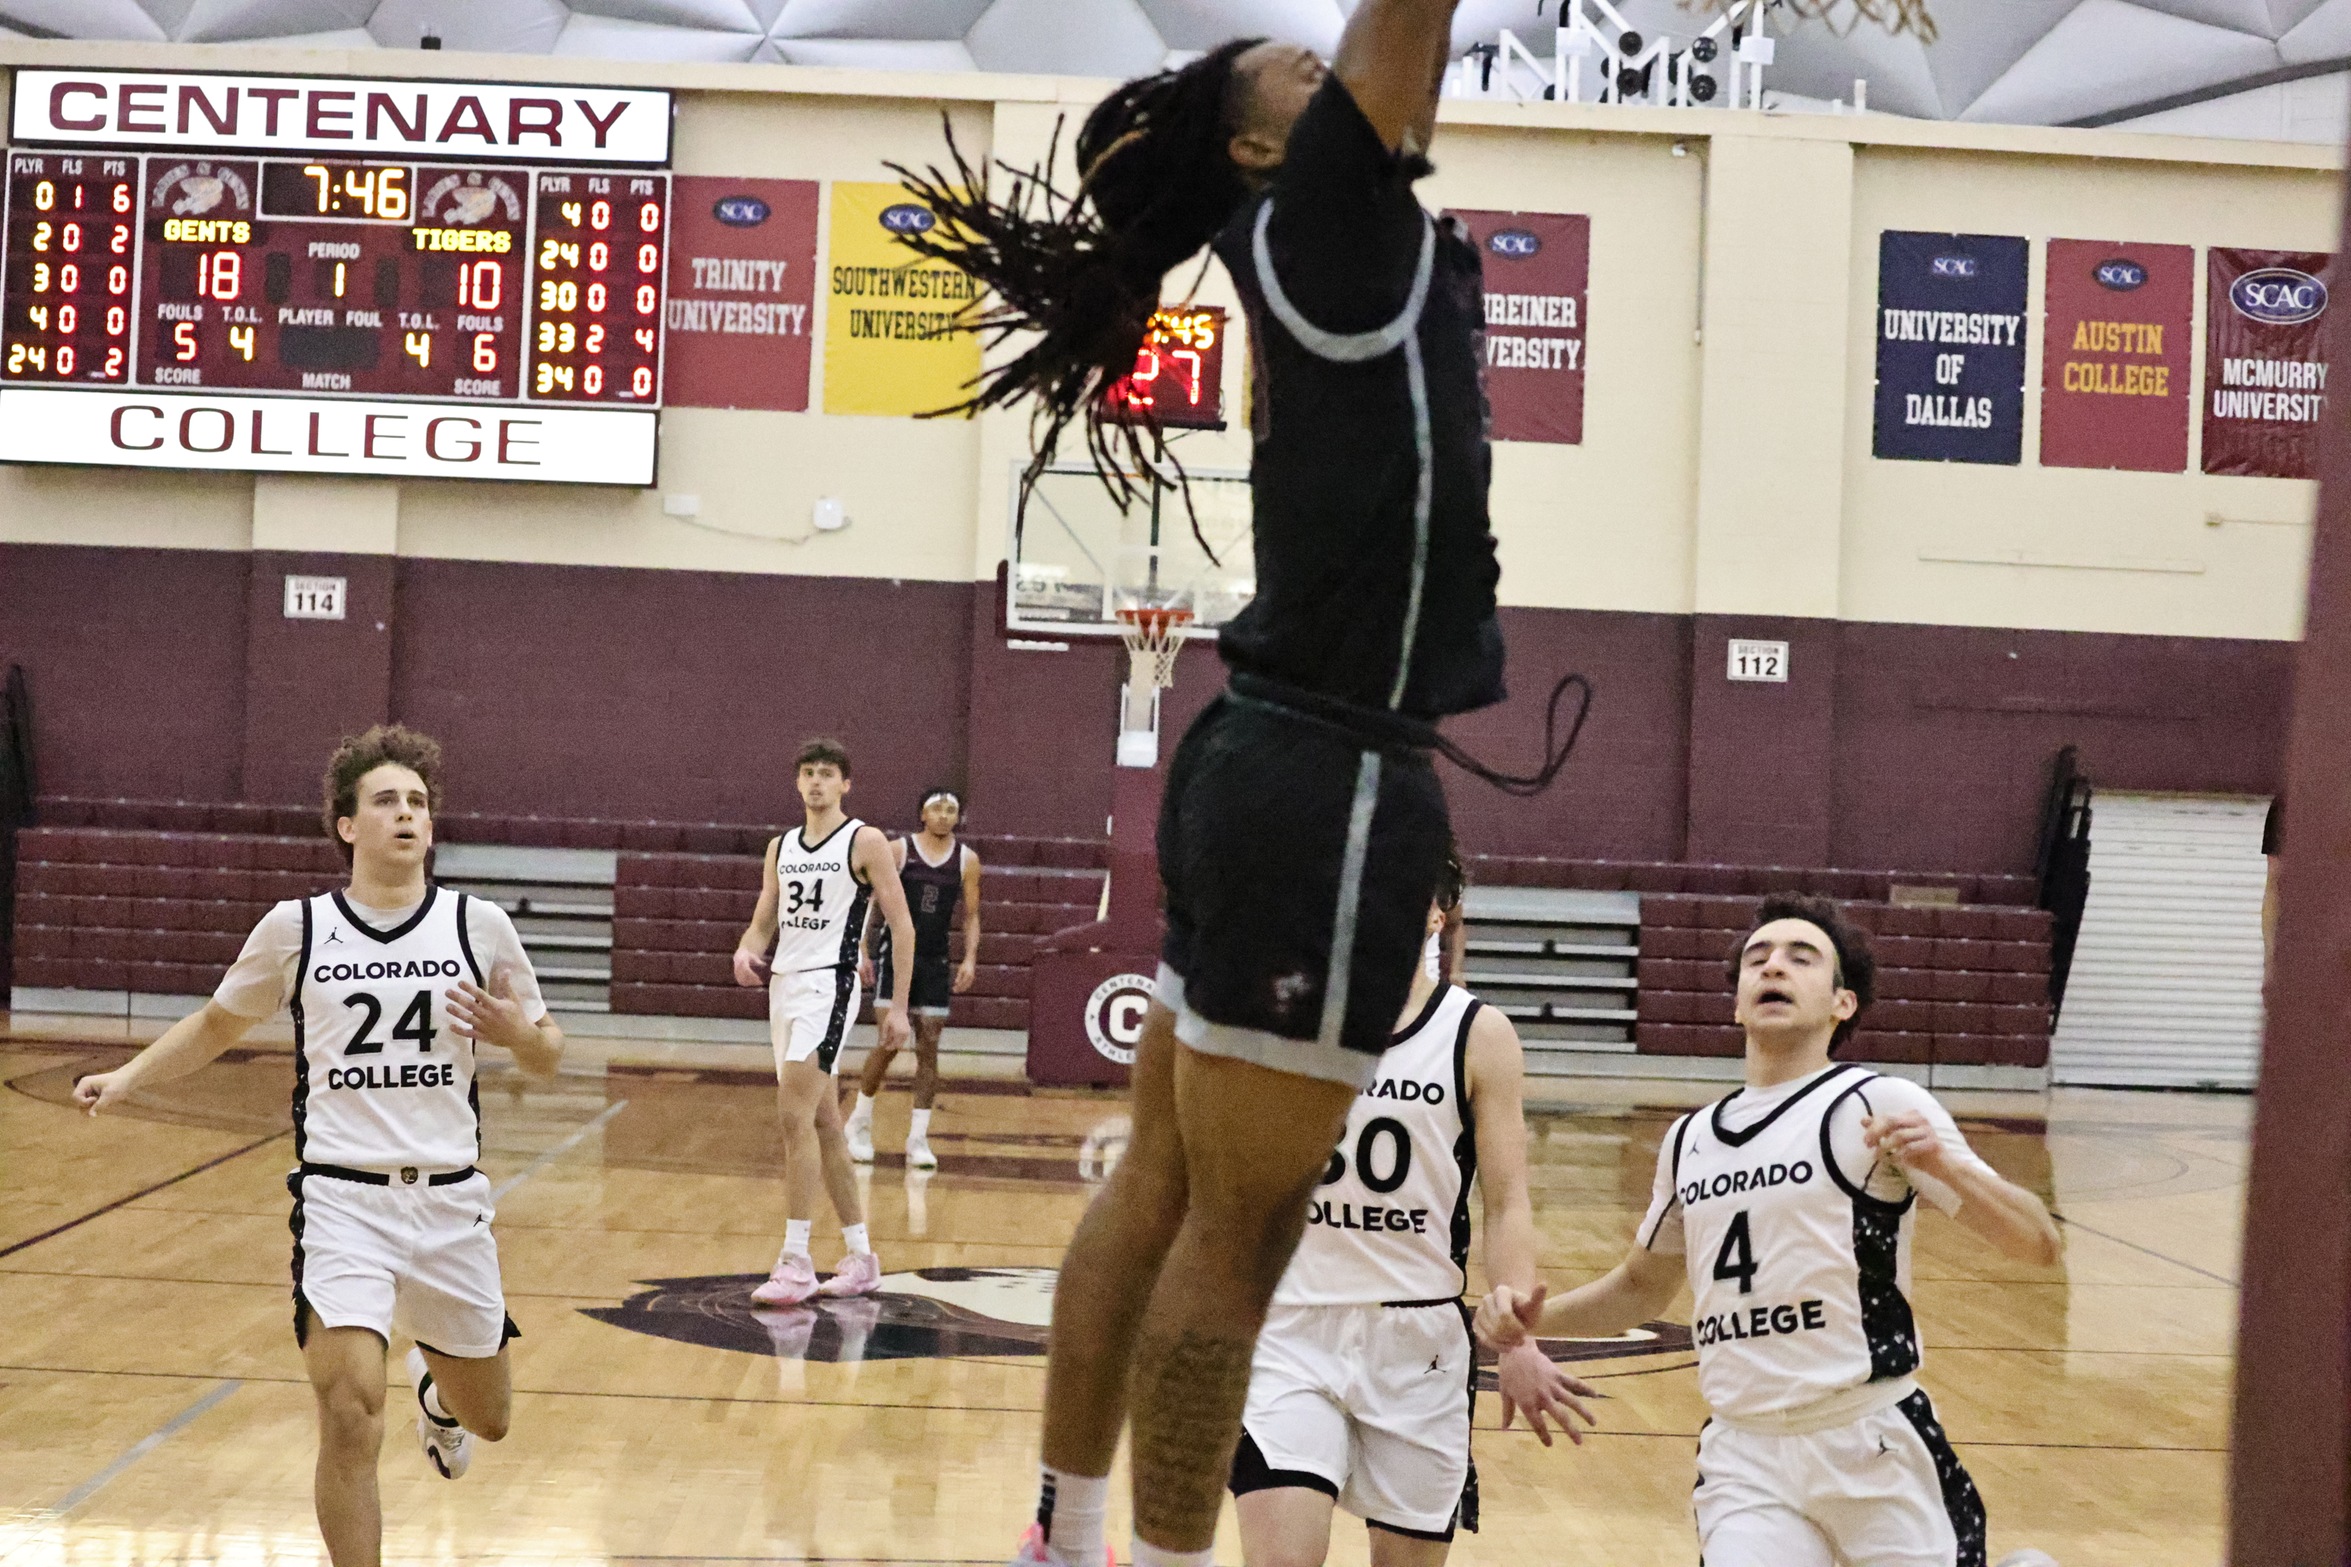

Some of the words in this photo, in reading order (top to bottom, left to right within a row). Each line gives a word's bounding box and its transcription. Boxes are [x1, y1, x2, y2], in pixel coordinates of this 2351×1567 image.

[49, 81, 632, 148] CENTENARY
[14, 158, 44, 173] PLYR
[61, 159, 82, 174] FLS
[103, 160, 126, 175] PTS
[35, 181, 54, 210] 0
[74, 184, 83, 209] 1
[112, 184, 130, 213] 6
[303, 165, 407, 219] 7:46
[540, 177, 571, 193] PLYR
[588, 178, 610, 194] FLS
[630, 179, 654, 195] PTS
[163, 218, 251, 243] GENTS
[561, 202, 581, 227] 4
[591, 201, 610, 230] 0
[640, 203, 659, 232] 0
[34, 222, 52, 251] 2
[62, 222, 80, 252] 0
[111, 225, 129, 253] 2
[308, 243, 360, 258] PERIOD
[412, 228, 511, 253] TIGERS
[539, 239, 580, 270] 24
[589, 242, 608, 271] 0
[638, 244, 657, 273] 0
[34, 262, 50, 293] 3
[60, 264, 78, 293] 0
[108, 265, 126, 294] 0
[198, 251, 240, 300] 18
[334, 262, 346, 298] 1
[458, 260, 502, 309] 10
[691, 257, 787, 292] TRINITY
[832, 266, 976, 300] SOUTHWESTERN
[2100, 266, 2141, 285] SCAC
[157, 304, 203, 321] FOULS
[539, 280, 578, 311] 30
[587, 283, 607, 312] 0
[636, 285, 656, 314] 0
[2245, 283, 2313, 310] SCAC
[29, 306, 48, 331] 4
[58, 305, 76, 334] 0
[106, 306, 125, 335] 0
[222, 306, 262, 324] T.O.L.
[278, 308, 334, 326] PLAYER
[345, 311, 383, 327] FOUL
[399, 313, 440, 330] T.O.L.
[457, 316, 503, 332] FOULS
[667, 299, 806, 336] UNIVERSITY
[1884, 309, 2020, 346] UNIVERSITY
[173, 322, 197, 361] 5
[229, 326, 254, 362] 4
[405, 332, 431, 368] 4
[473, 333, 496, 372] 6
[538, 321, 576, 353] 33
[585, 324, 605, 354] 2
[635, 328, 654, 353] 4
[2072, 320, 2164, 354] AUSTIN
[8, 344, 46, 374] 24
[56, 345, 75, 375] 0
[105, 348, 122, 377] 2
[154, 367, 201, 385] SCORE
[1936, 354, 1965, 385] OF
[2223, 358, 2329, 390] MCMURRY
[302, 372, 351, 389] MATCH
[454, 378, 501, 395] SCORE
[537, 362, 574, 393] 34
[583, 365, 603, 394] 0
[633, 367, 651, 396] 0
[2063, 362, 2169, 397] COLLEGE
[1905, 394, 1992, 429] DALLAS
[2213, 390, 2328, 422] UNIVERSIT
[109, 405, 543, 466] COLLEGE
[295, 592, 333, 612] 114
[1738, 656, 1778, 676] 112
[780, 862, 841, 875] COLORADO
[787, 878, 824, 914] 34
[313, 960, 461, 983] COLORADO
[342, 990, 438, 1056] 24
[1109, 994, 1149, 1043] C
[328, 1063, 454, 1090] COLLEGE
[1713, 1209, 1758, 1294] 4
[1697, 1300, 1826, 1346] COLLEGE
